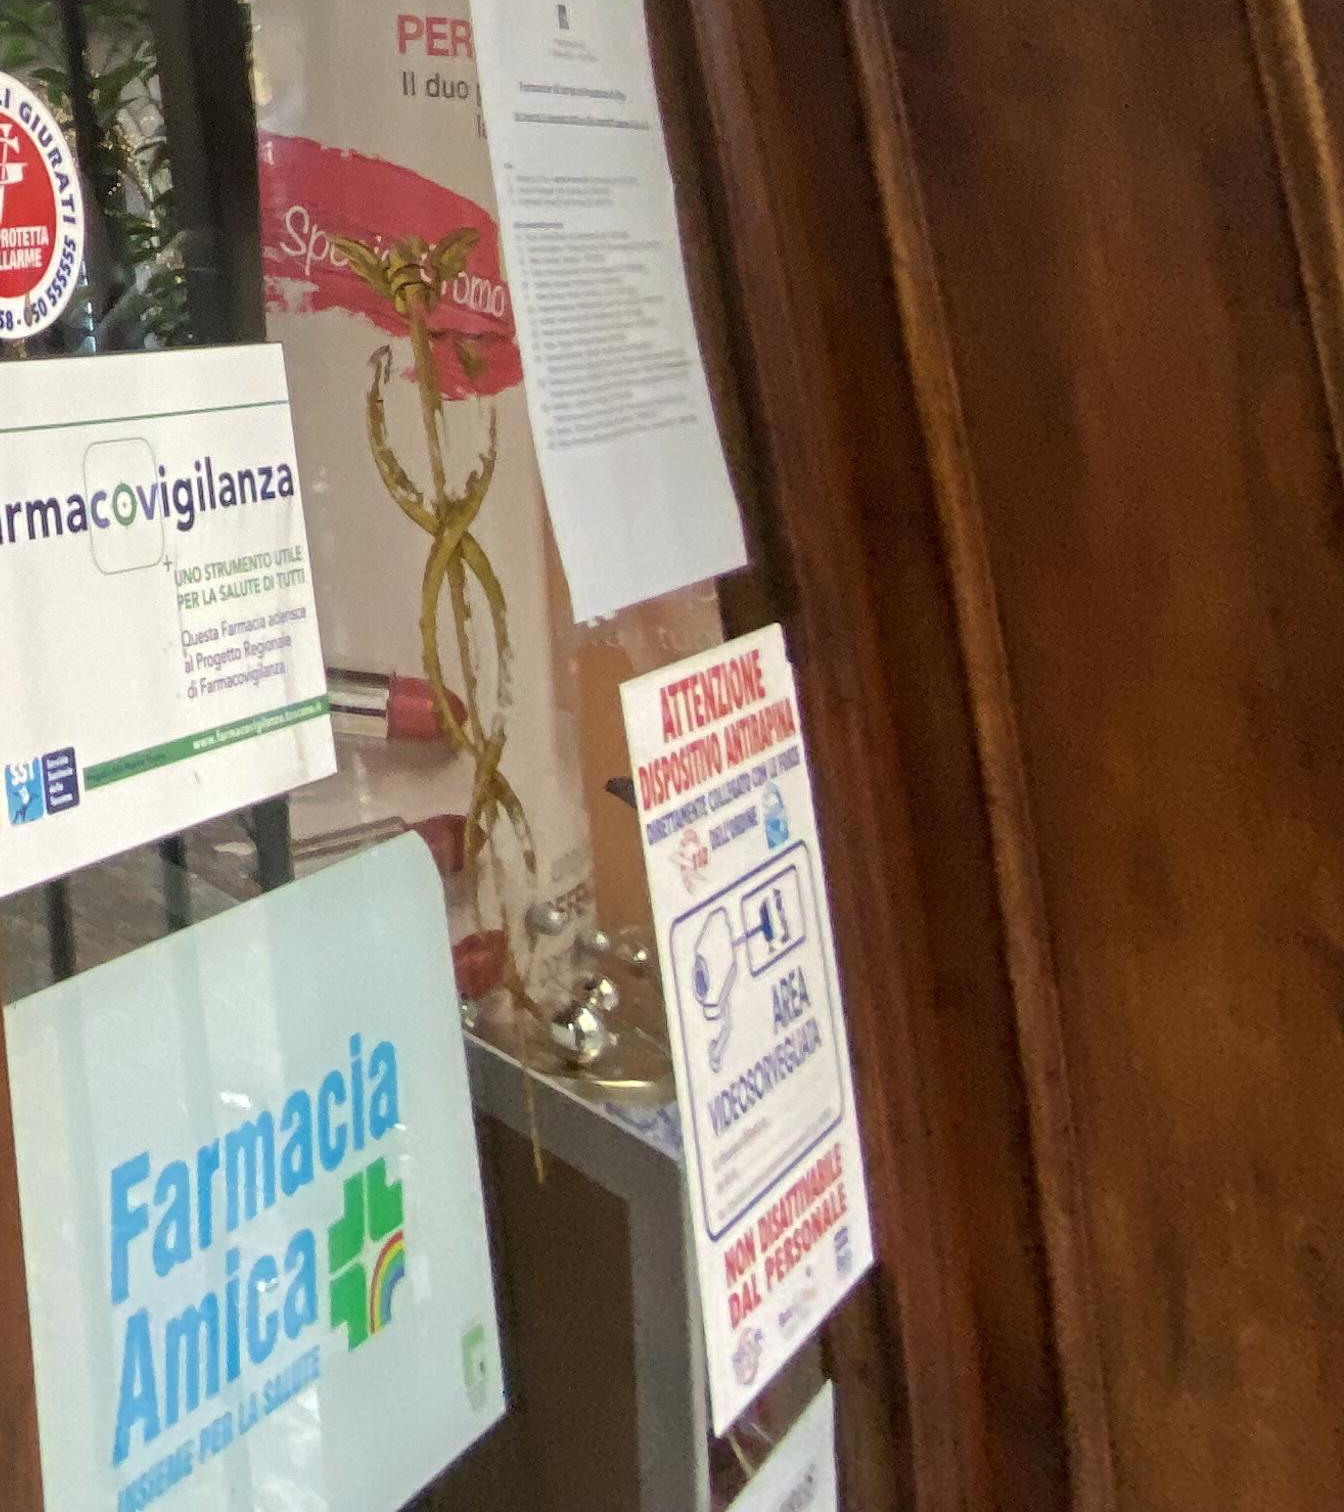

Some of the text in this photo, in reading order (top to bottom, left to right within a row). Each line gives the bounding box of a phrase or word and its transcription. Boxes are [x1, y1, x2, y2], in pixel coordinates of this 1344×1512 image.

[425, 72, 470, 99] duo
[18, 101, 78, 226] GIURATI
[23, 297, 48, 328] 50
[174, 545, 304, 587] UNO STRUMENTO UTILE
[177, 568, 305, 610] PER LA SALUTE DI TUTTI
[181, 626, 220, 648] Questa
[221, 616, 266, 638] Farmacia
[196, 647, 242, 672] Progetto
[659, 648, 767, 744] ATTENZIONE
[638, 731, 723, 811] DISPOSITIVO
[771, 965, 811, 1036] AREA
[111, 1031, 400, 1307] Farmacia
[725, 1227, 757, 1288] NON
[728, 1273, 762, 1330] DAL
[764, 1182, 849, 1290] PERSONALE
[112, 1228, 319, 1468] Amica
